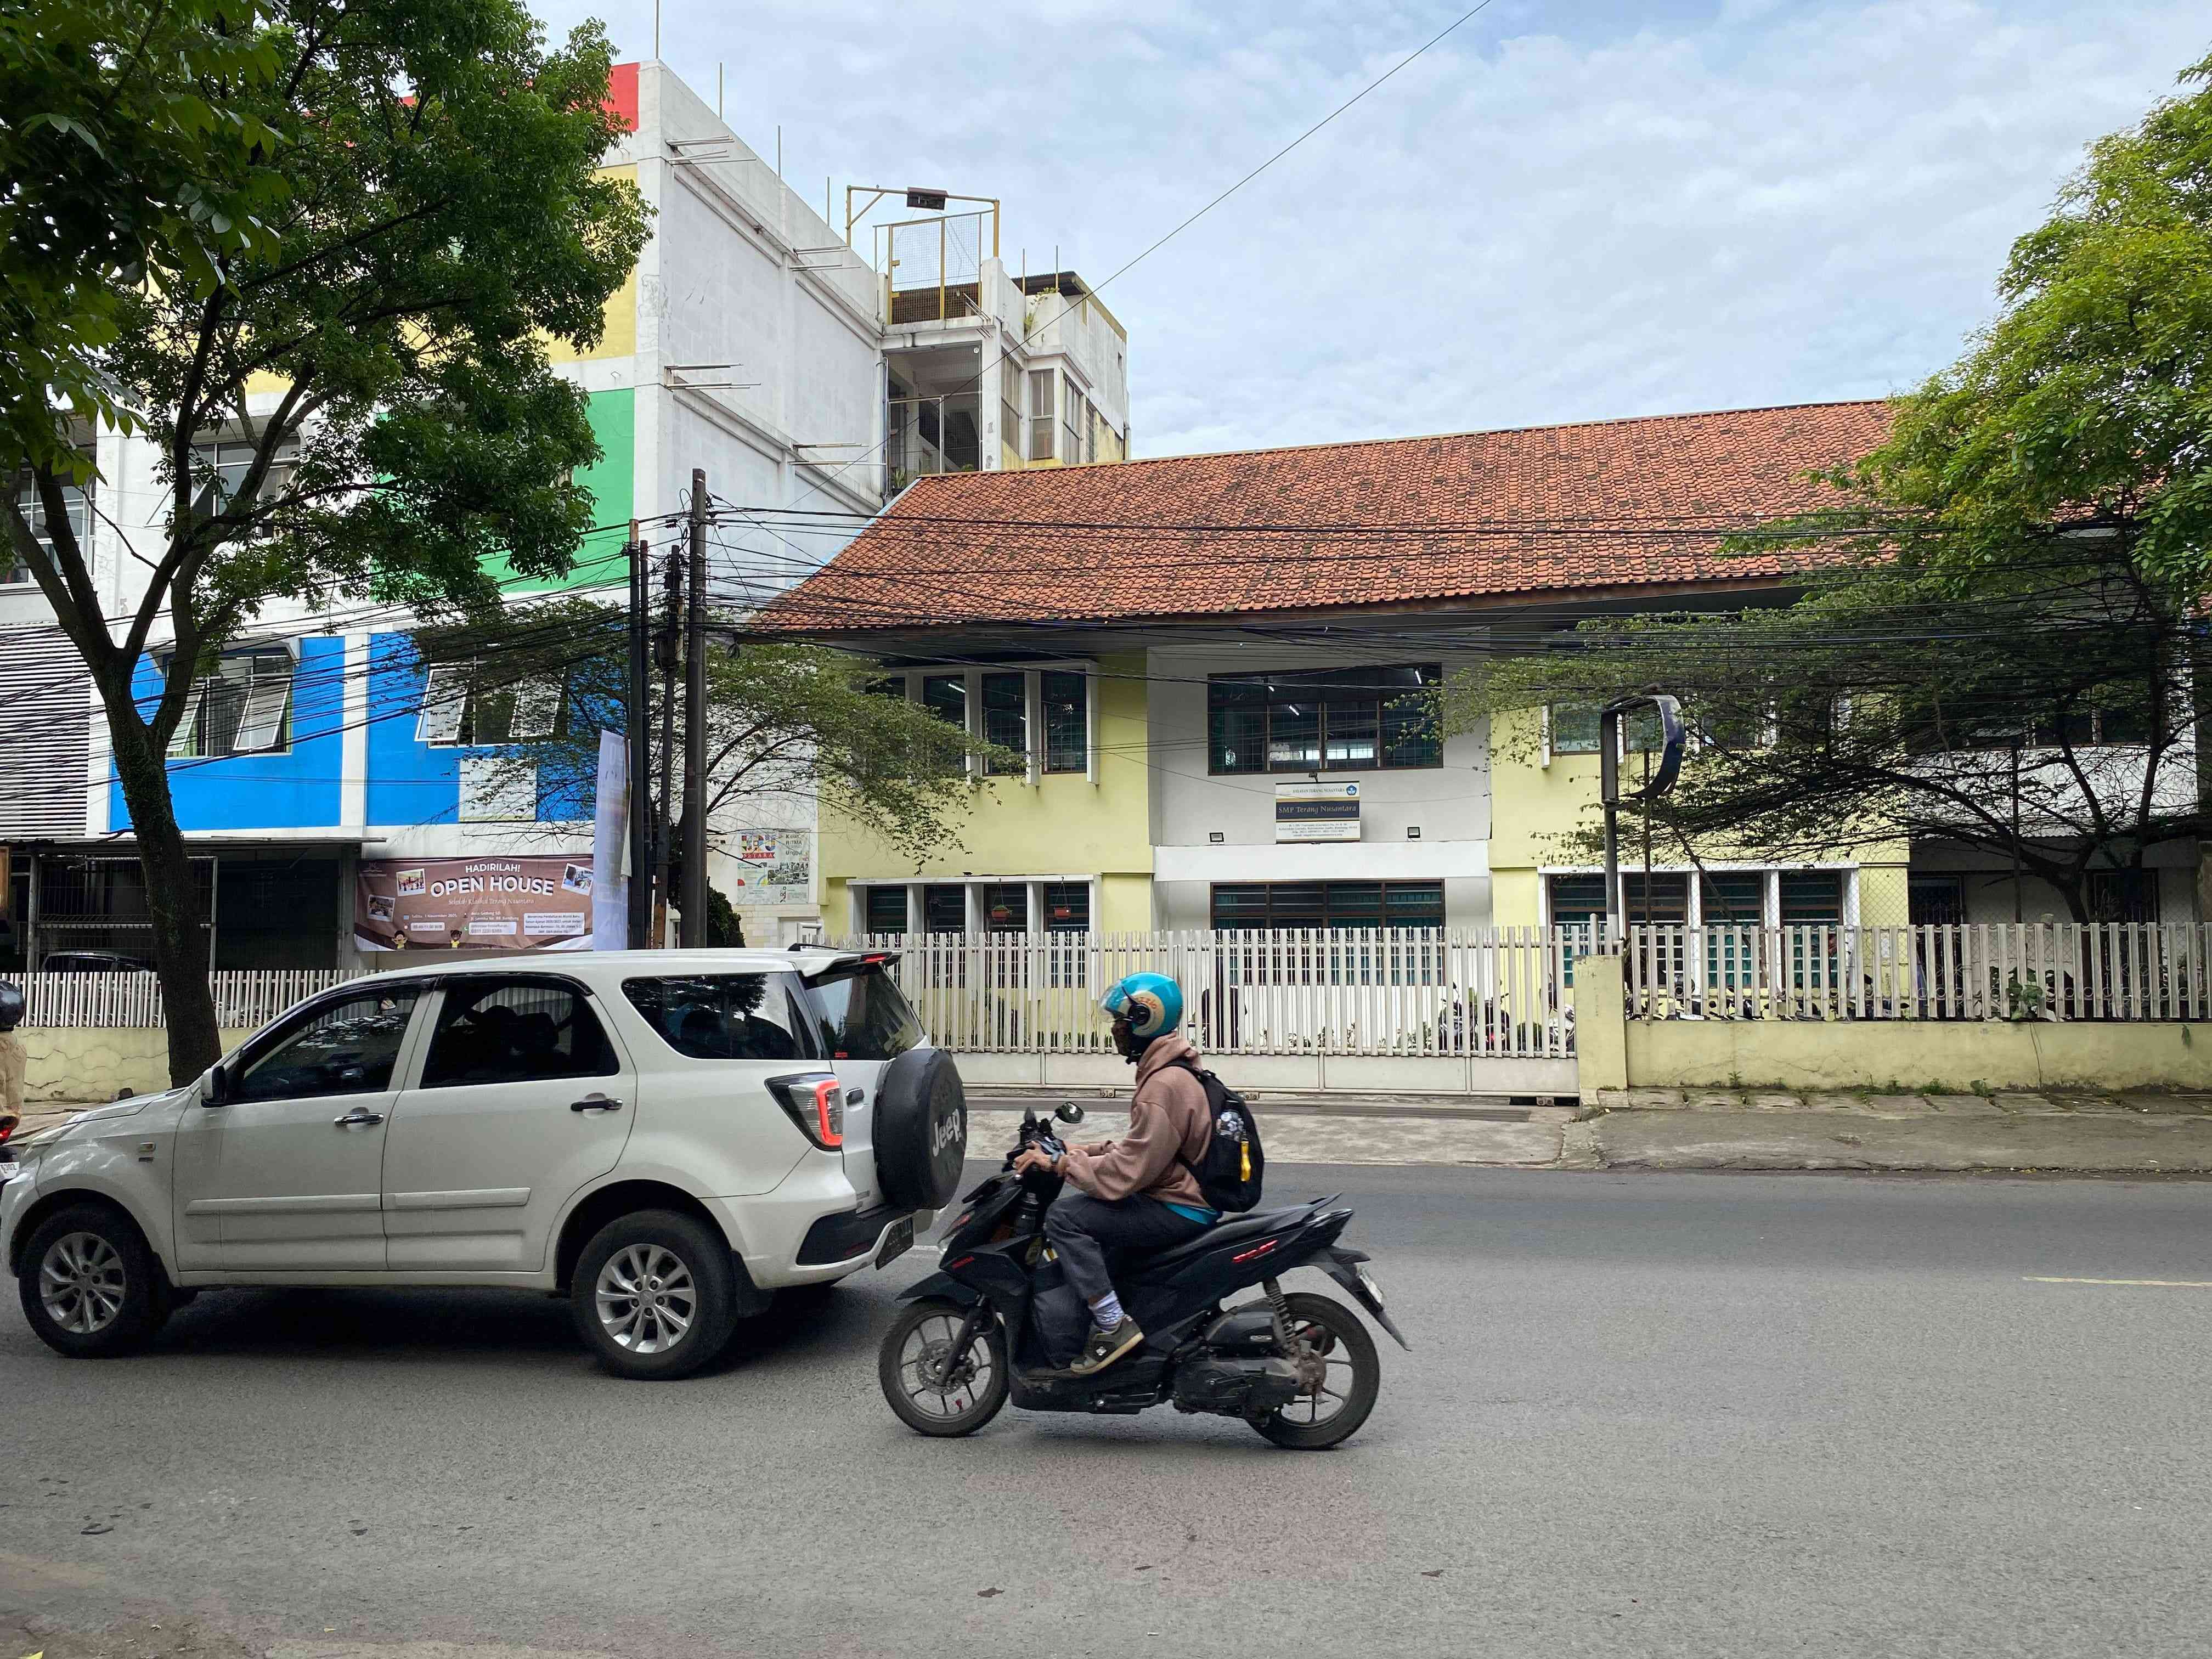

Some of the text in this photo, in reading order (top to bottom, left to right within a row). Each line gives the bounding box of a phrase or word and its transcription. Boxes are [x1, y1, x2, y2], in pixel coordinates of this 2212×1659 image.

[1297, 806, 1318, 814] Terang
[465, 863, 521, 873] HADIRILAH!
[430, 875, 555, 897] OPEN HOUSE
[933, 1108, 961, 1157] Jeep
